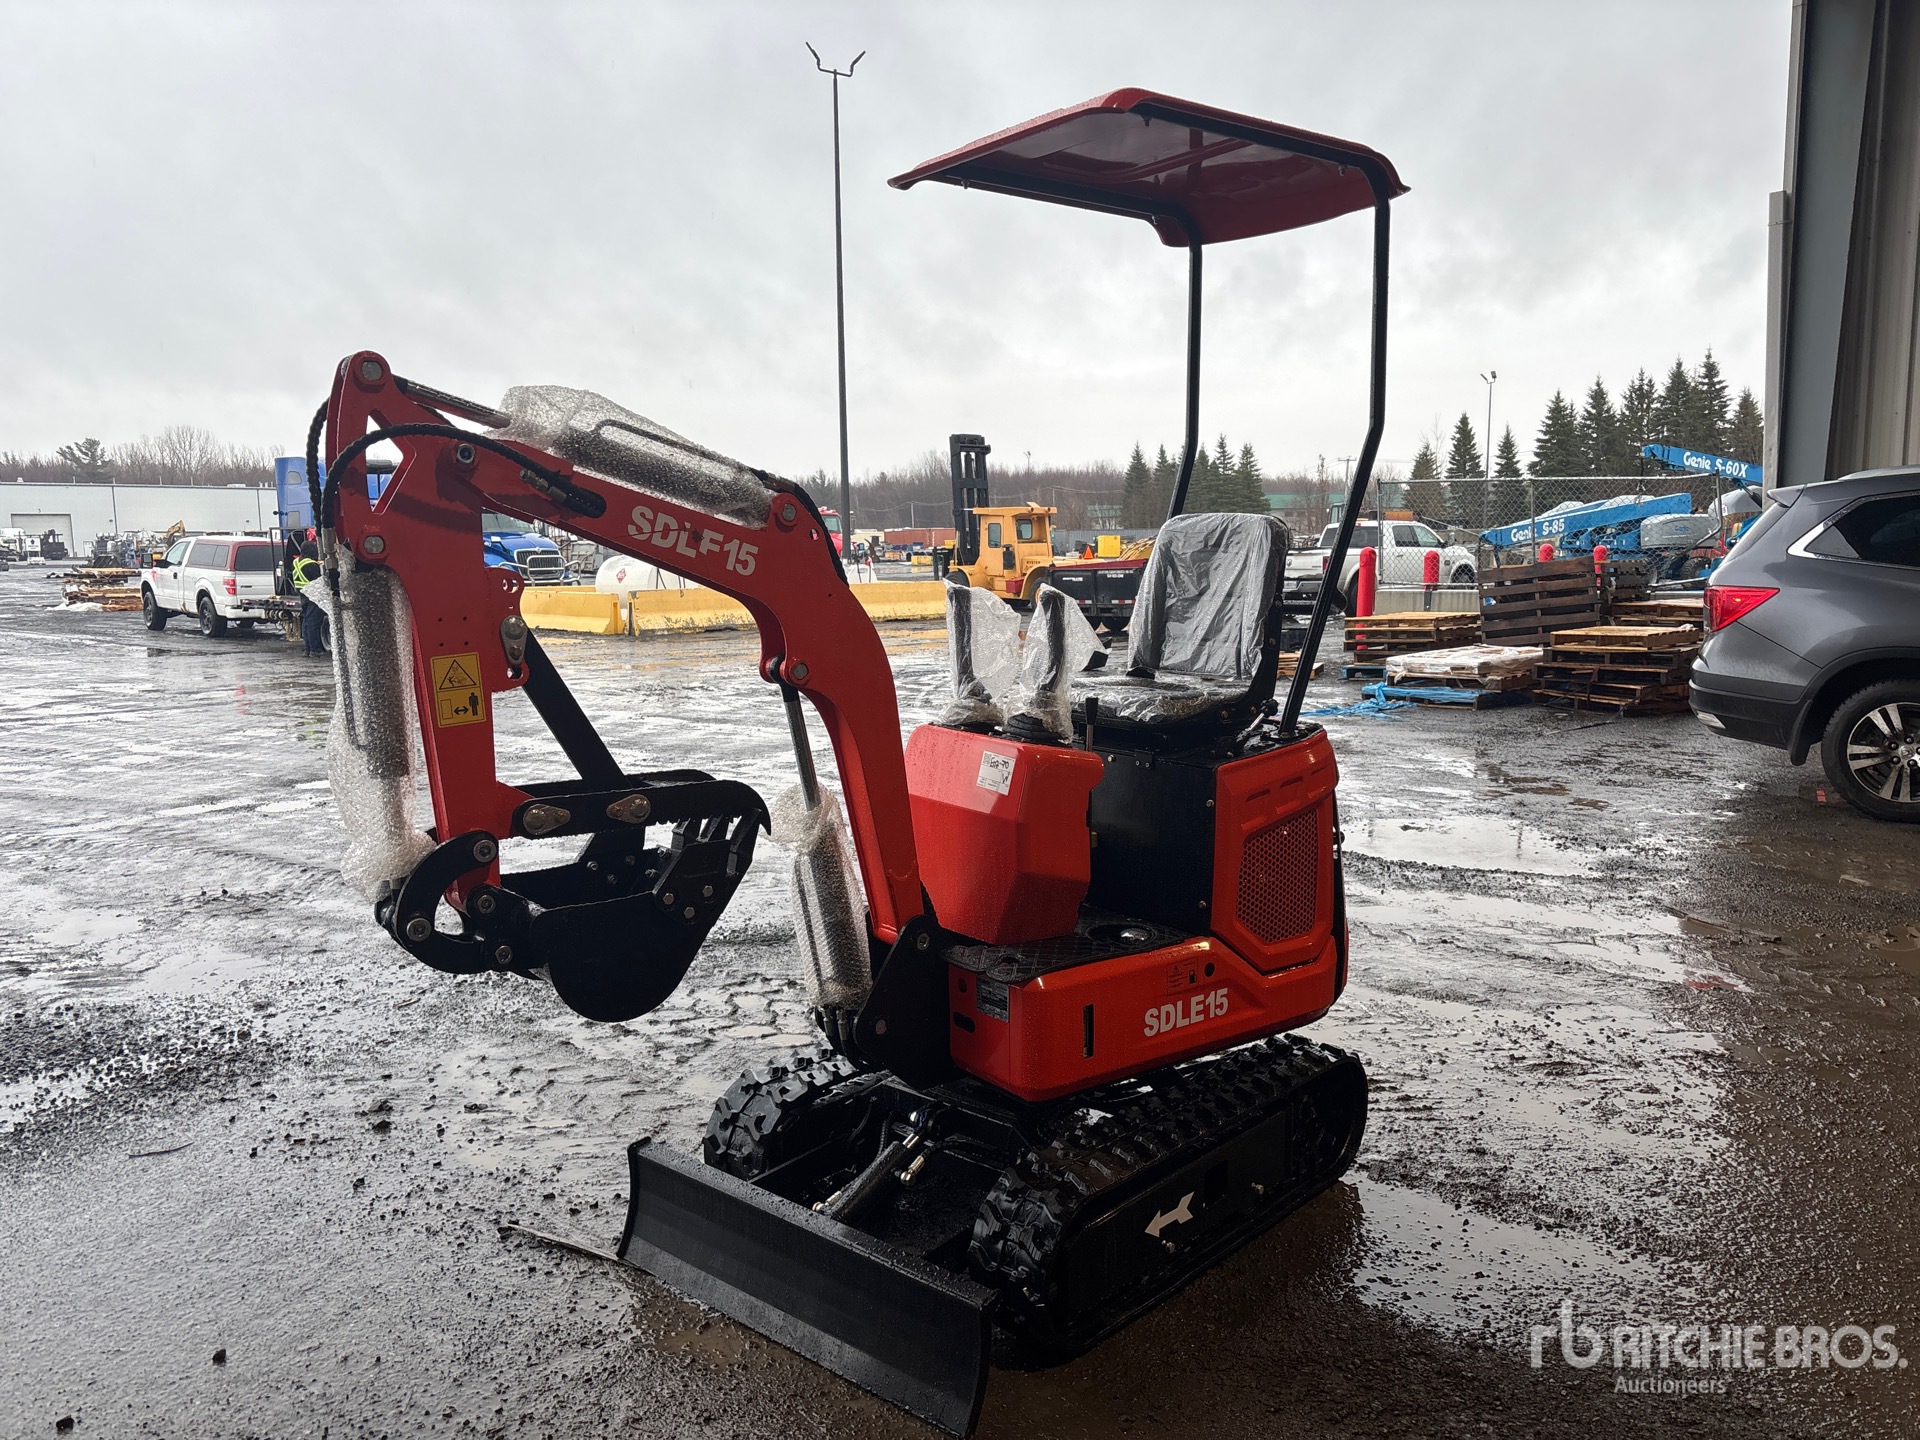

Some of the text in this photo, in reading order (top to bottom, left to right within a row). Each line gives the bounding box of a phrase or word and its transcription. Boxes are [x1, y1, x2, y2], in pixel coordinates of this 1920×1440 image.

[1683, 451, 1748, 478] Genie S-60X
[1541, 518, 1565, 536] S-85
[1143, 988, 1229, 1037] SDLE15
